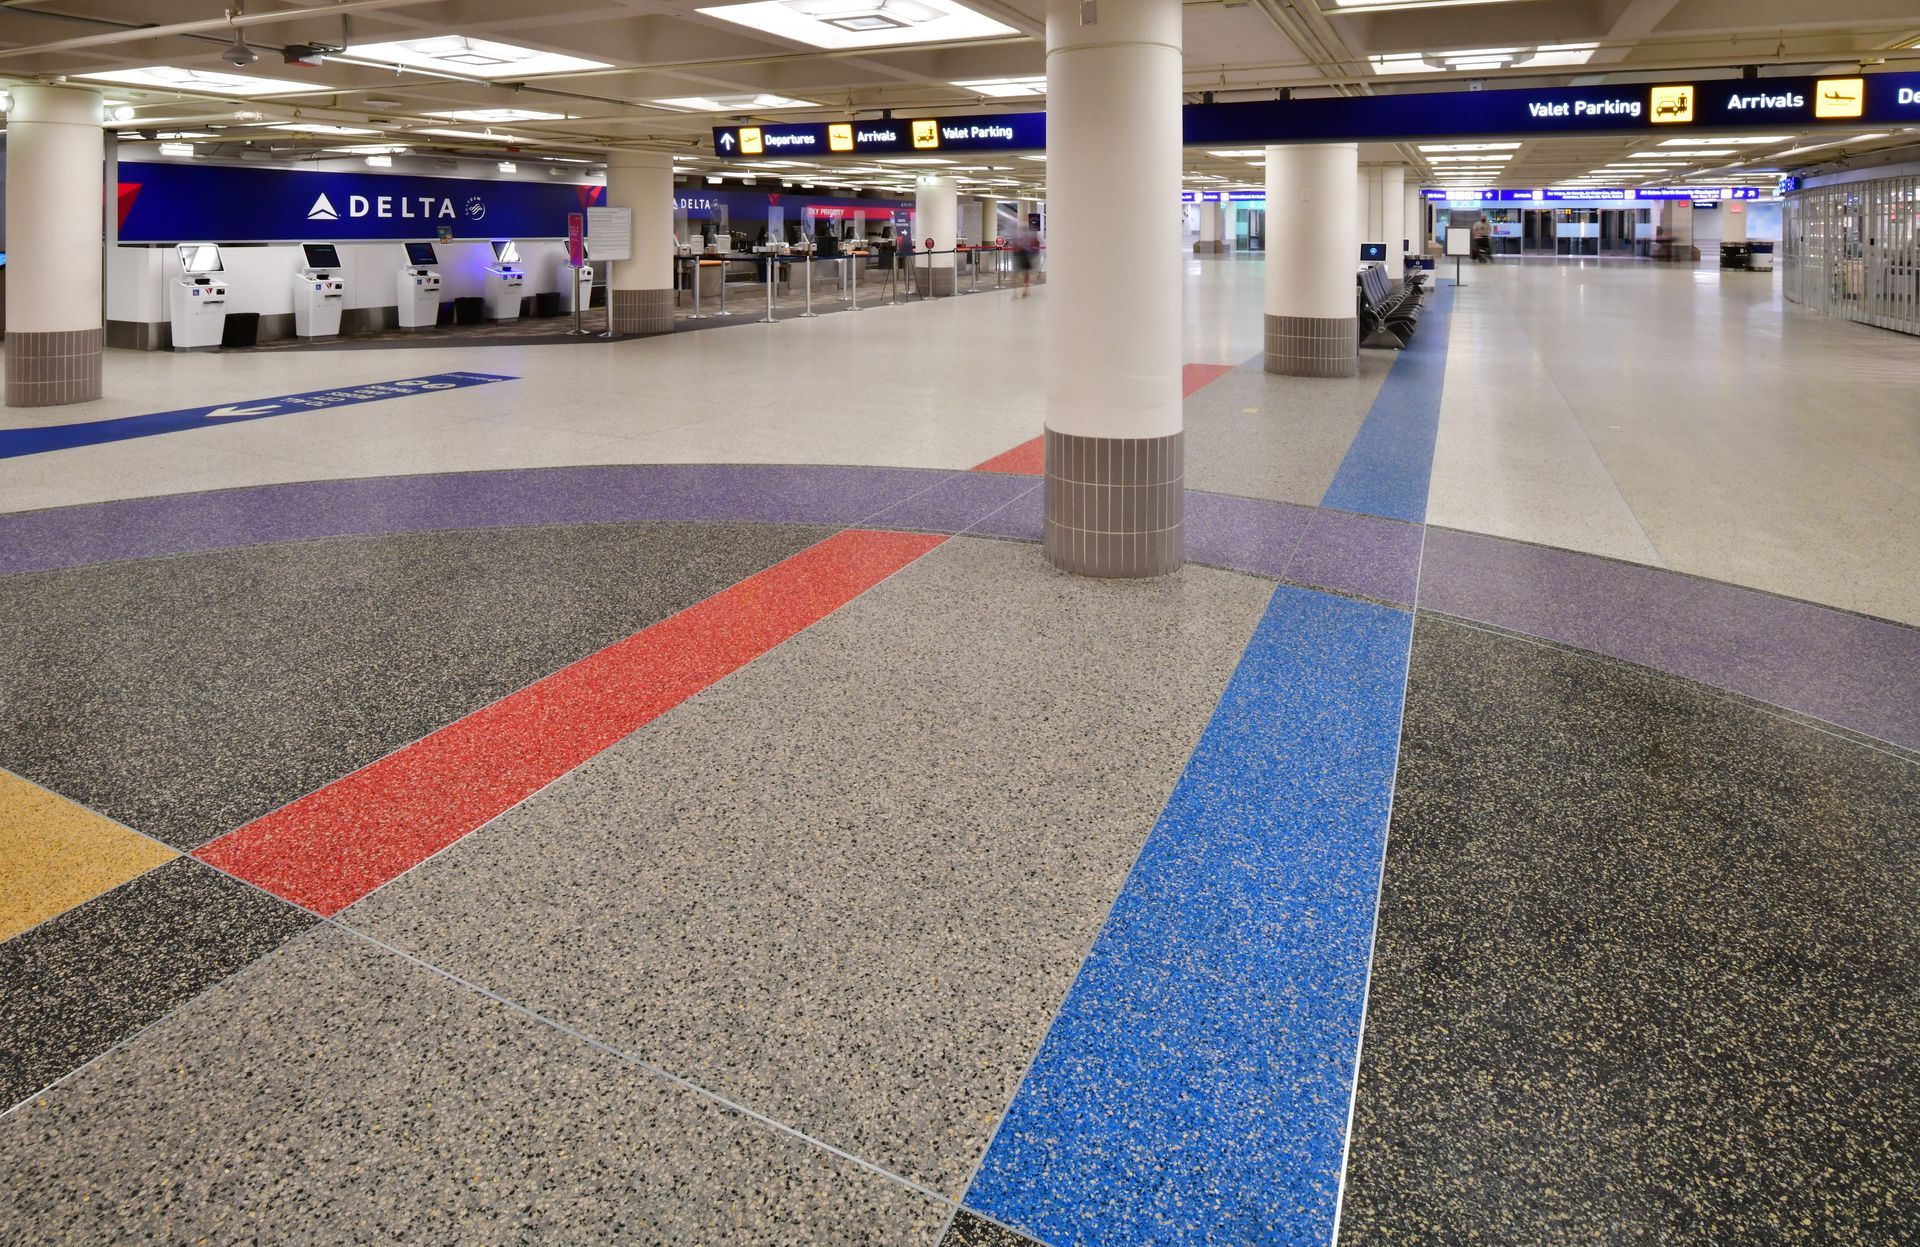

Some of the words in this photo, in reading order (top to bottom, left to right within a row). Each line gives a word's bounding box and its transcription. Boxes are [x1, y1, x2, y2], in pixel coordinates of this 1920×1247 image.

[1529, 101, 1569, 118] Valet
[1575, 99, 1641, 118] Parking
[1727, 92, 1804, 110] Arrivals
[857, 129, 896, 142] Arrivals
[943, 126, 968, 139] Valet
[971, 125, 1013, 140] Parking
[764, 134, 815, 147] Departures
[349, 195, 456, 219] DELTA
[680, 198, 711, 210] DELTA
